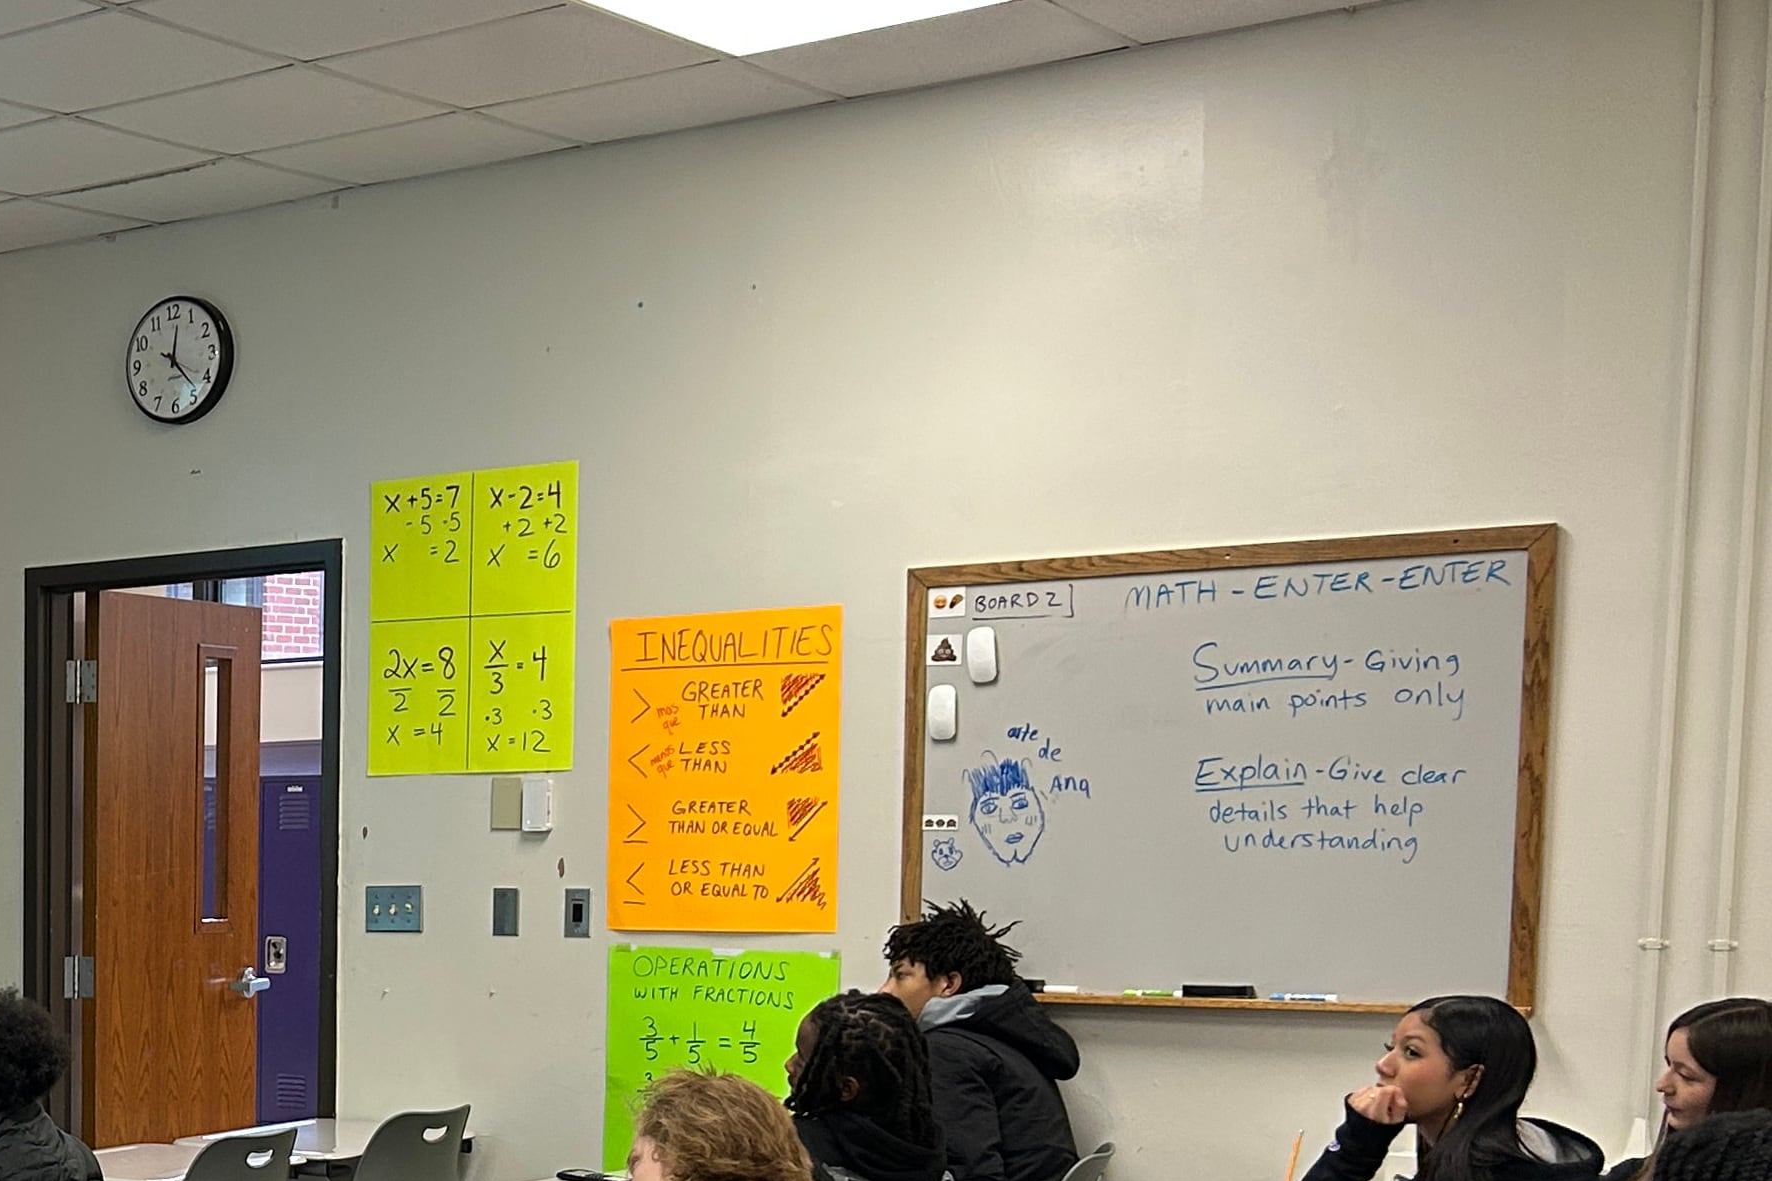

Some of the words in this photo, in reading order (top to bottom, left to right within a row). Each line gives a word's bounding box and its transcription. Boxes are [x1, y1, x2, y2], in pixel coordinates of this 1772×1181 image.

[167, 304, 181, 321] 12
[208, 344, 216, 361] 3
[133, 360, 141, 376] 9
[171, 397, 179, 414] 6
[635, 624, 833, 663] INEQUALITIES
[1365, 648, 1459, 676] Giving
[681, 678, 764, 702] GREATER
[1206, 697, 1270, 714] main
[1288, 689, 1367, 718] points
[1394, 681, 1464, 721] only
[698, 703, 745, 720] THAN
[679, 740, 731, 755] LESS
[1038, 737, 1061, 762] de
[680, 758, 727, 774] THAN
[1401, 764, 1467, 785] clear
[672, 799, 751, 816] GREATER
[1210, 800, 1287, 824] details
[1301, 795, 1357, 819] that
[1374, 794, 1423, 827] help
[668, 820, 705, 834] THAN
[712, 821, 728, 834] OR
[733, 821, 778, 837] EQUAL
[1224, 828, 1418, 864] understanding
[668, 859, 710, 876] LESS
[720, 862, 765, 879] THAN
[671, 881, 693, 896] OR
[701, 883, 748, 897] EQUAL
[753, 884, 769, 900] TO
[633, 955, 790, 981] OPERATIONS
[634, 987, 678, 1002] WITH
[693, 985, 794, 1010] FRACTIONS
